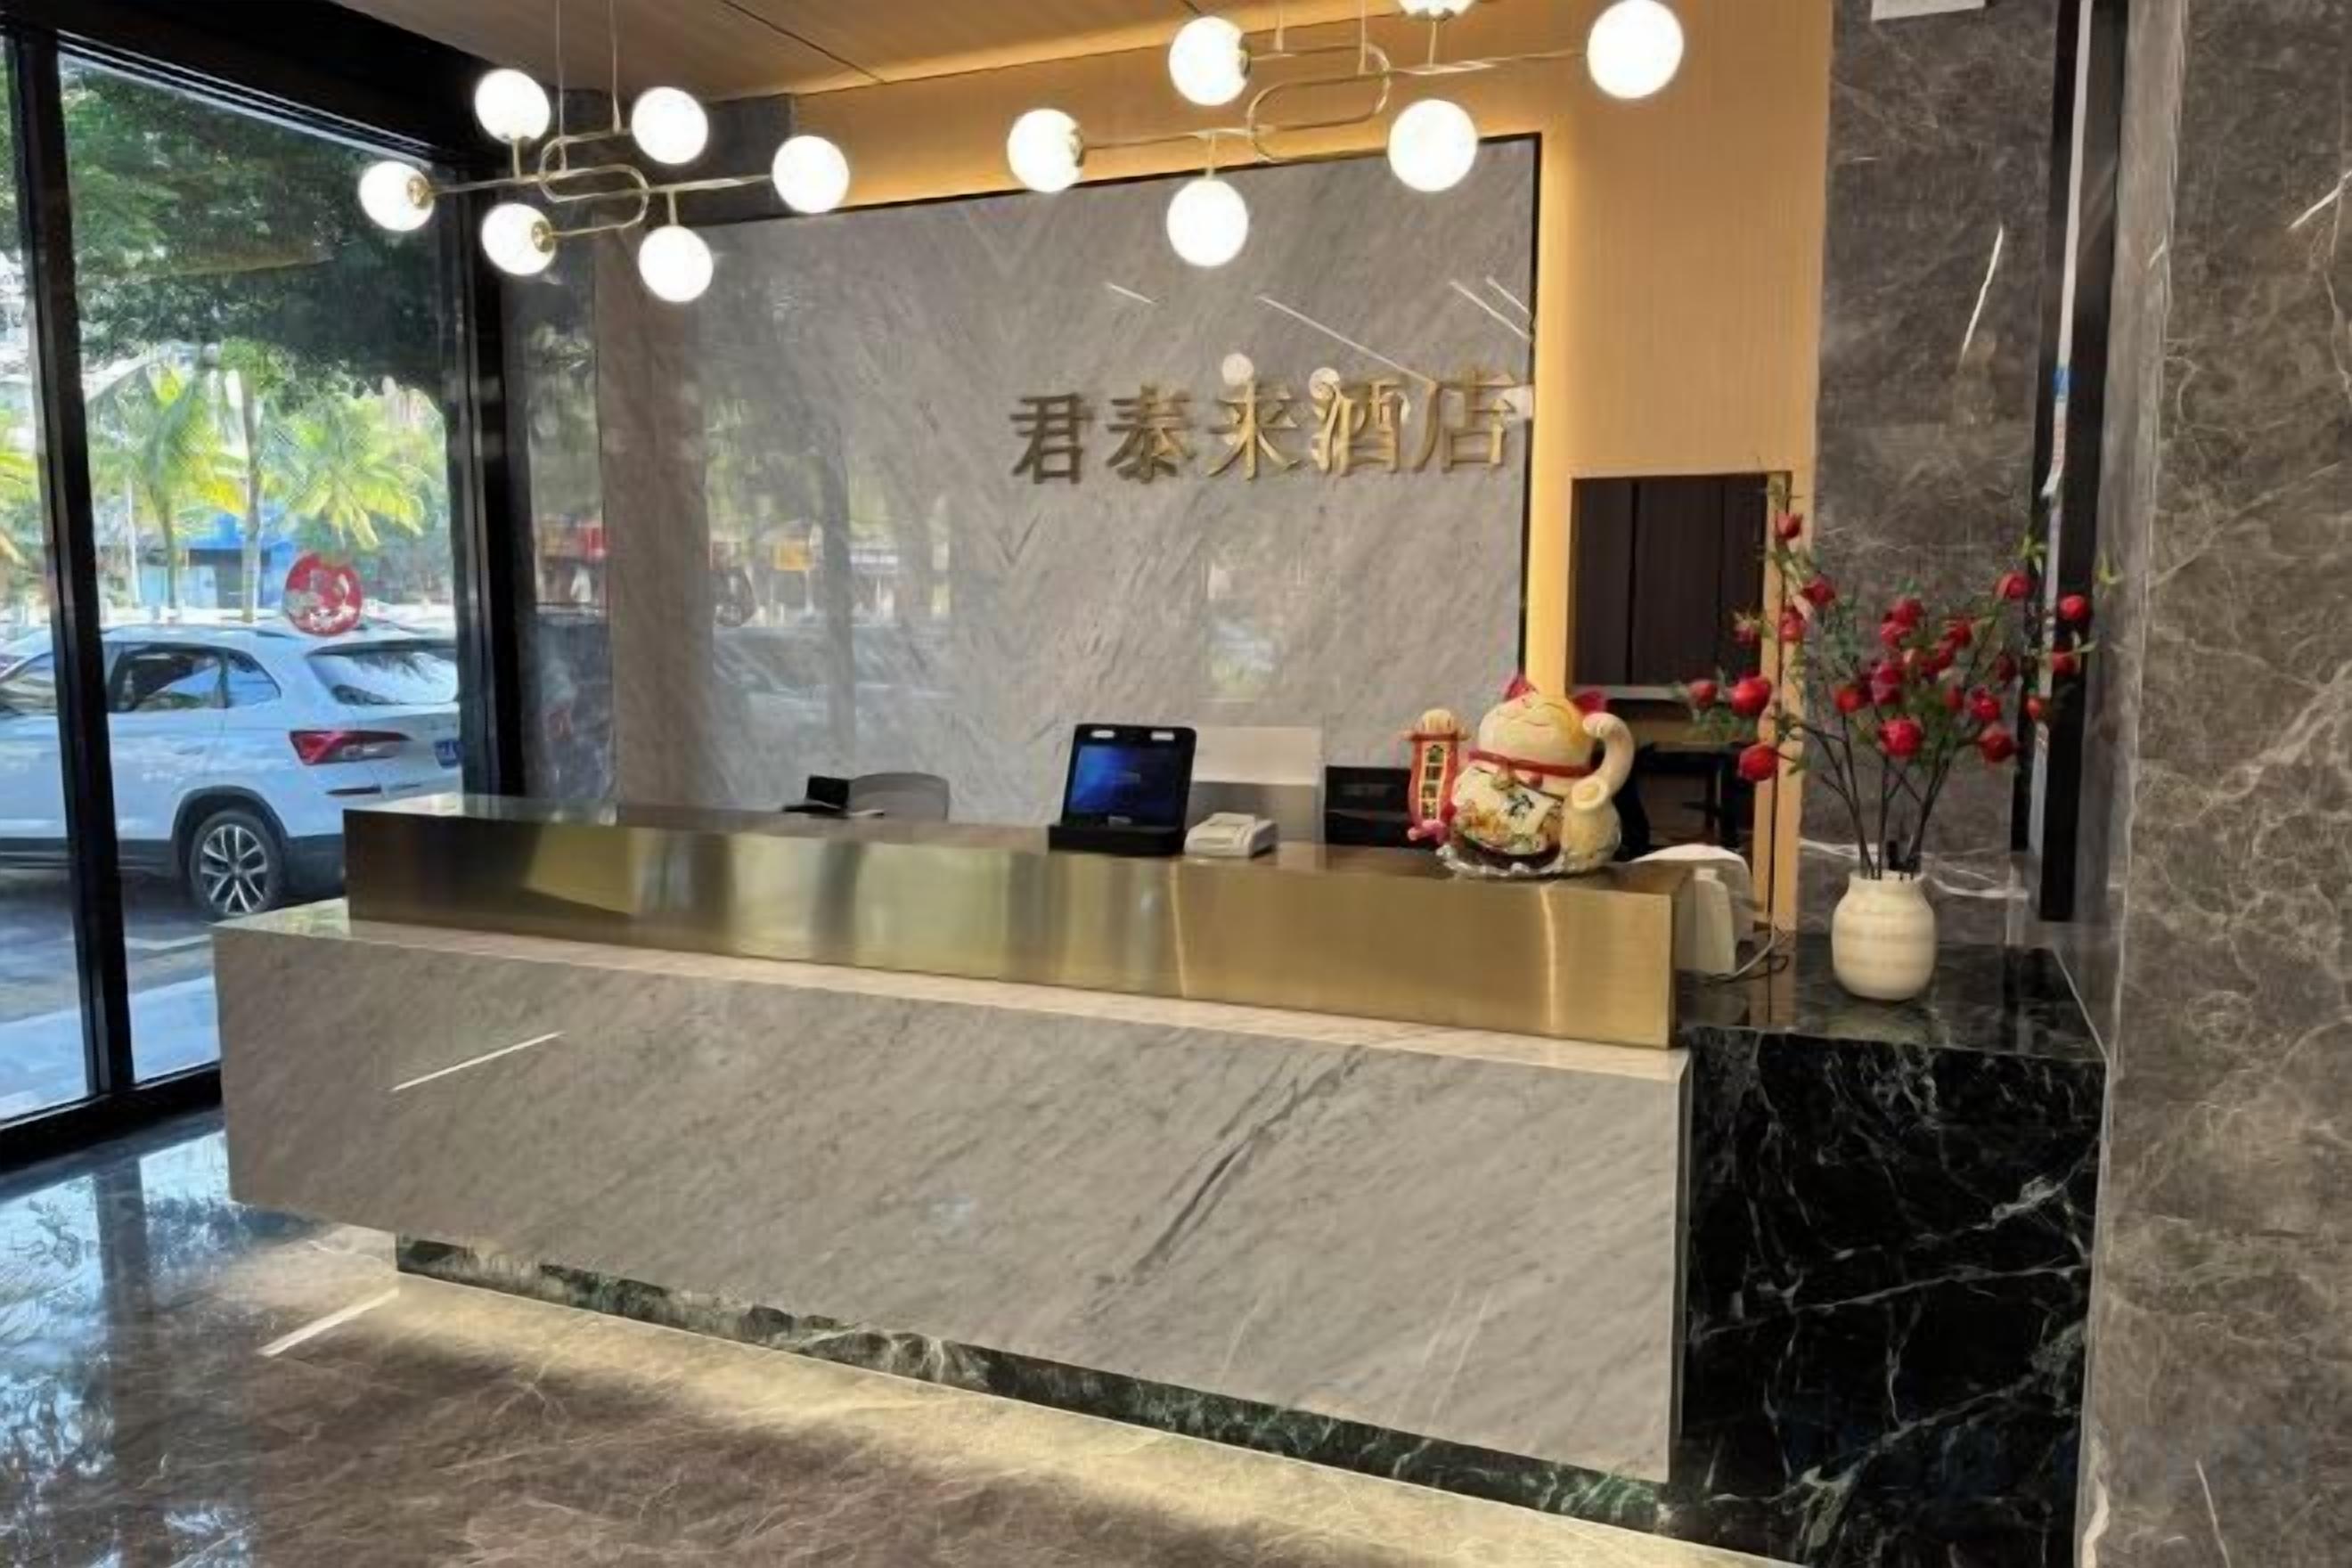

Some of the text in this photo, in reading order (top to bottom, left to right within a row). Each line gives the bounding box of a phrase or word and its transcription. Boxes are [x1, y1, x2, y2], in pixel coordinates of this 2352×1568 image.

[1009, 370, 1516, 484] 君泰来酒店
